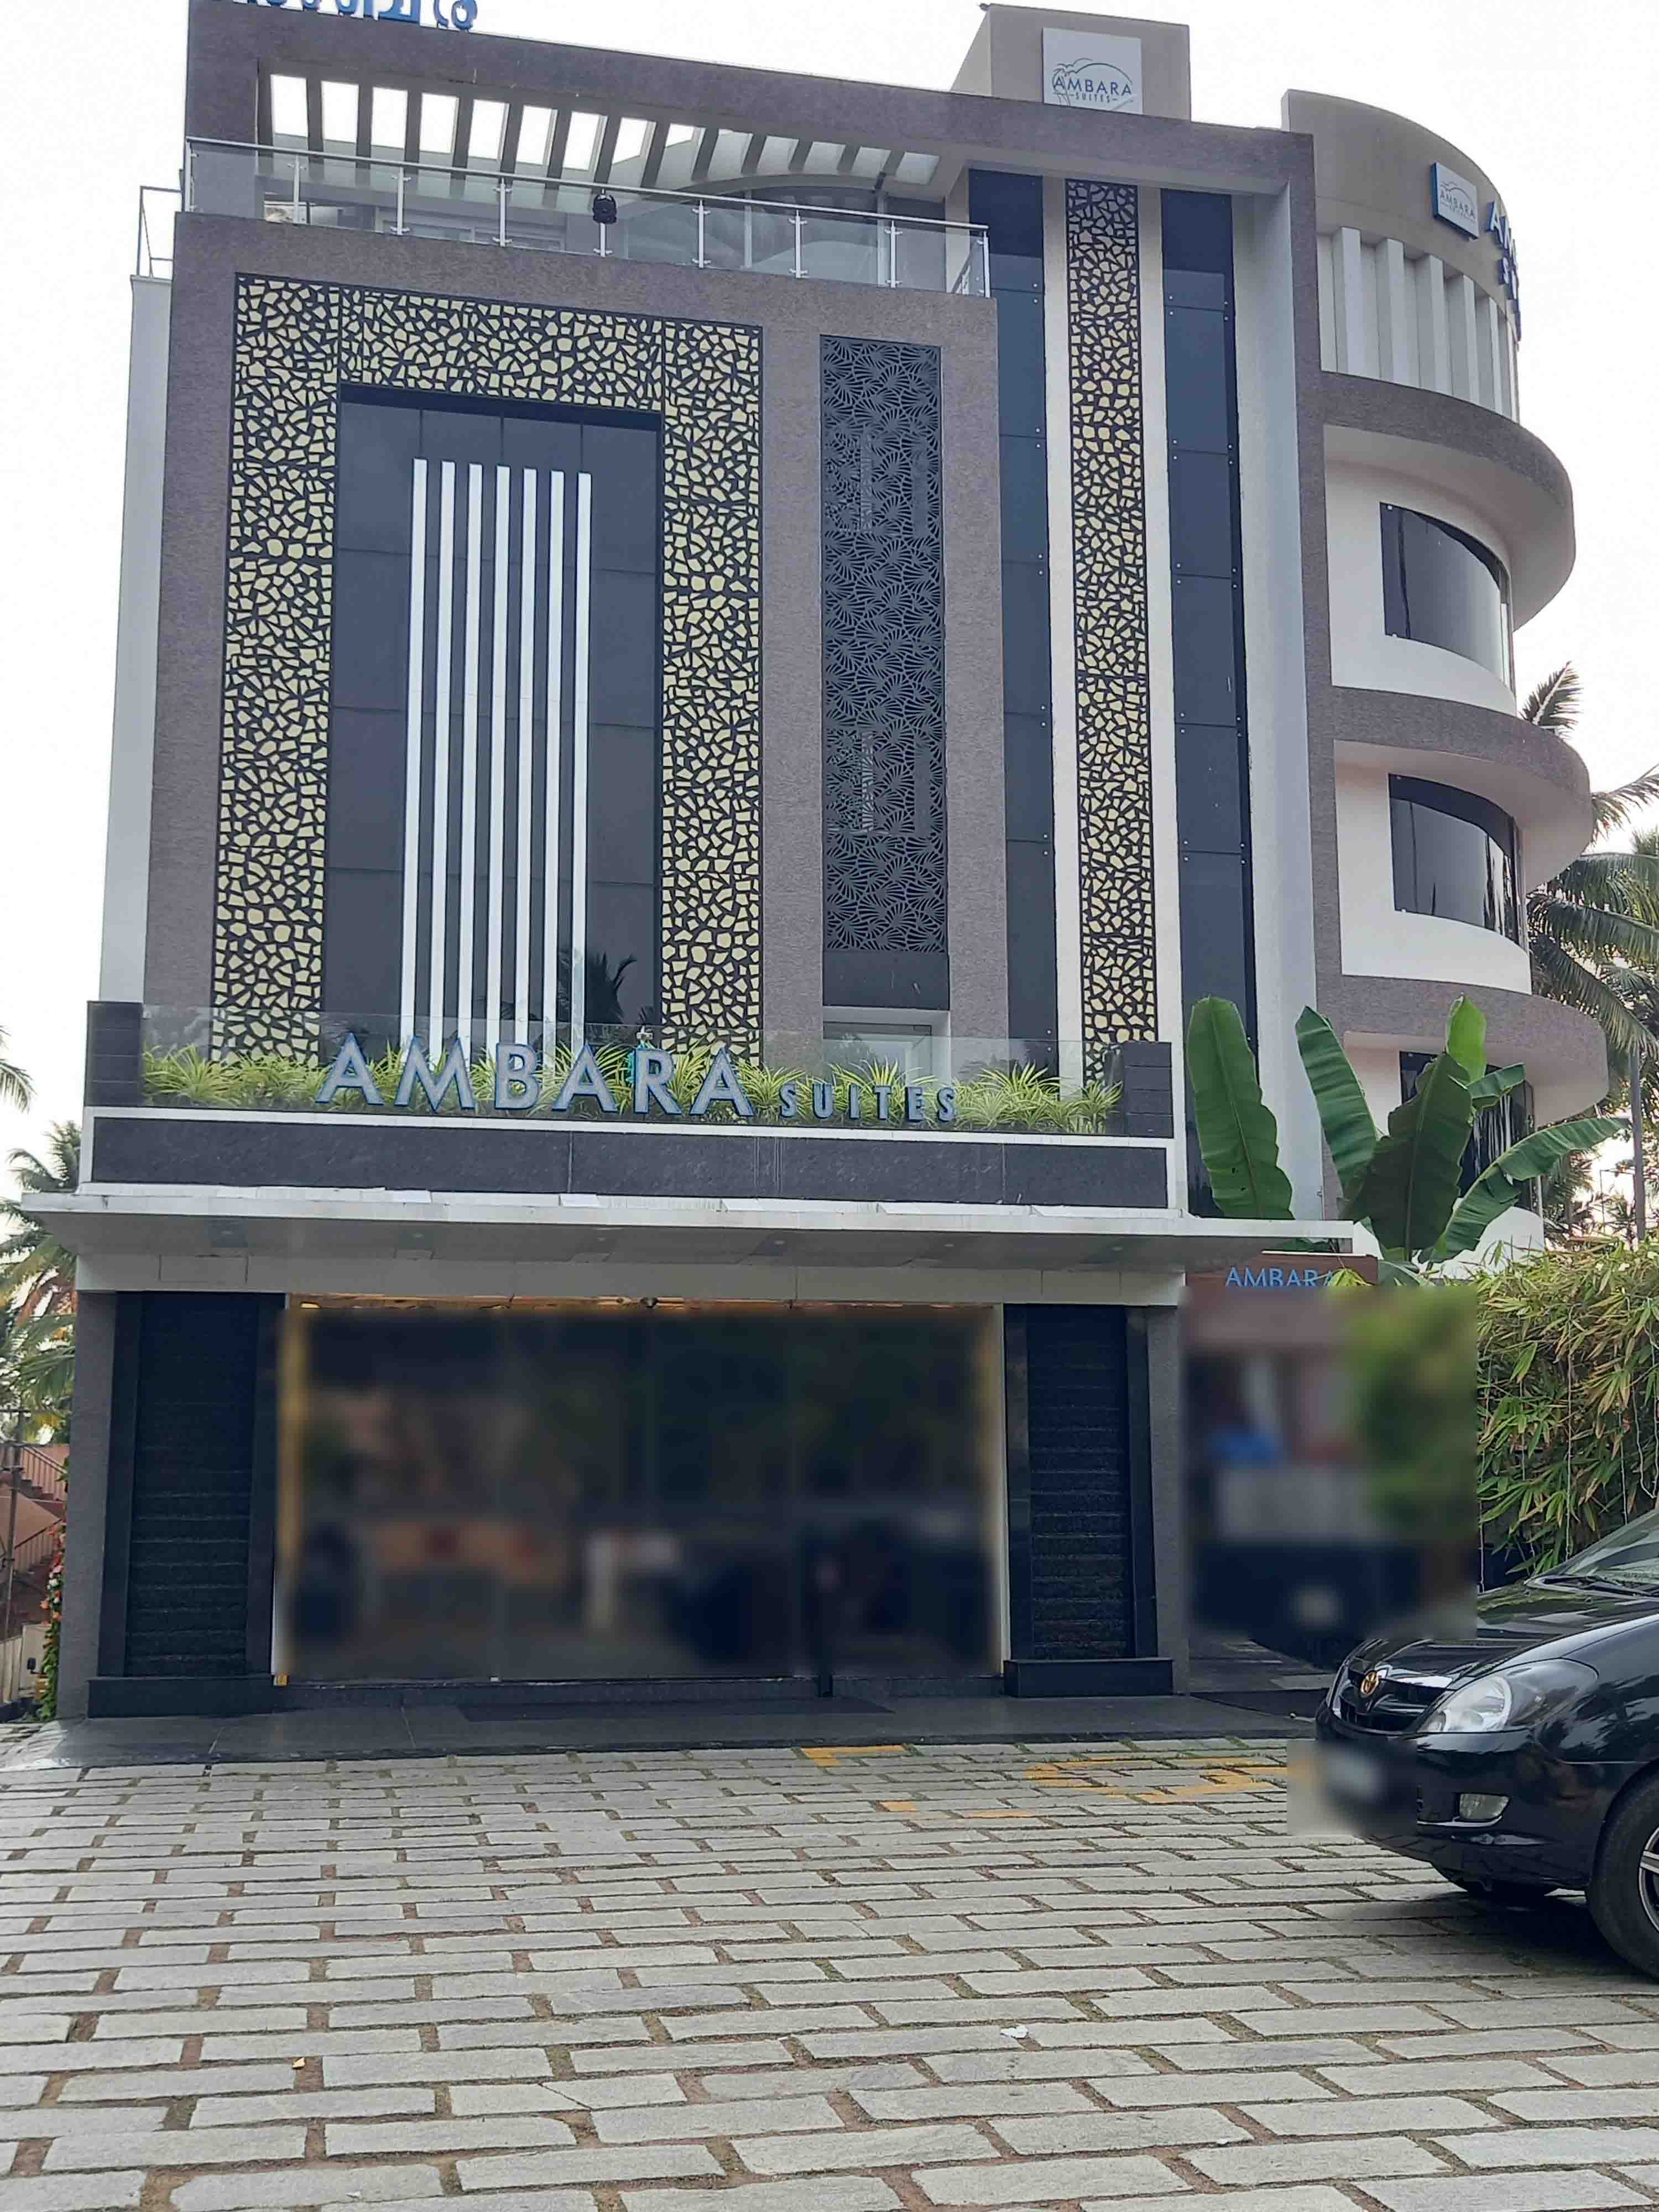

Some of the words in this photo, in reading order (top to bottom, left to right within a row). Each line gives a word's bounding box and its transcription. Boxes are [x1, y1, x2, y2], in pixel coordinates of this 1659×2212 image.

[1055, 76, 1131, 96] AMBARA
[315, 1032, 754, 1118] AMBARA
[779, 1083, 957, 1123] SUITES
